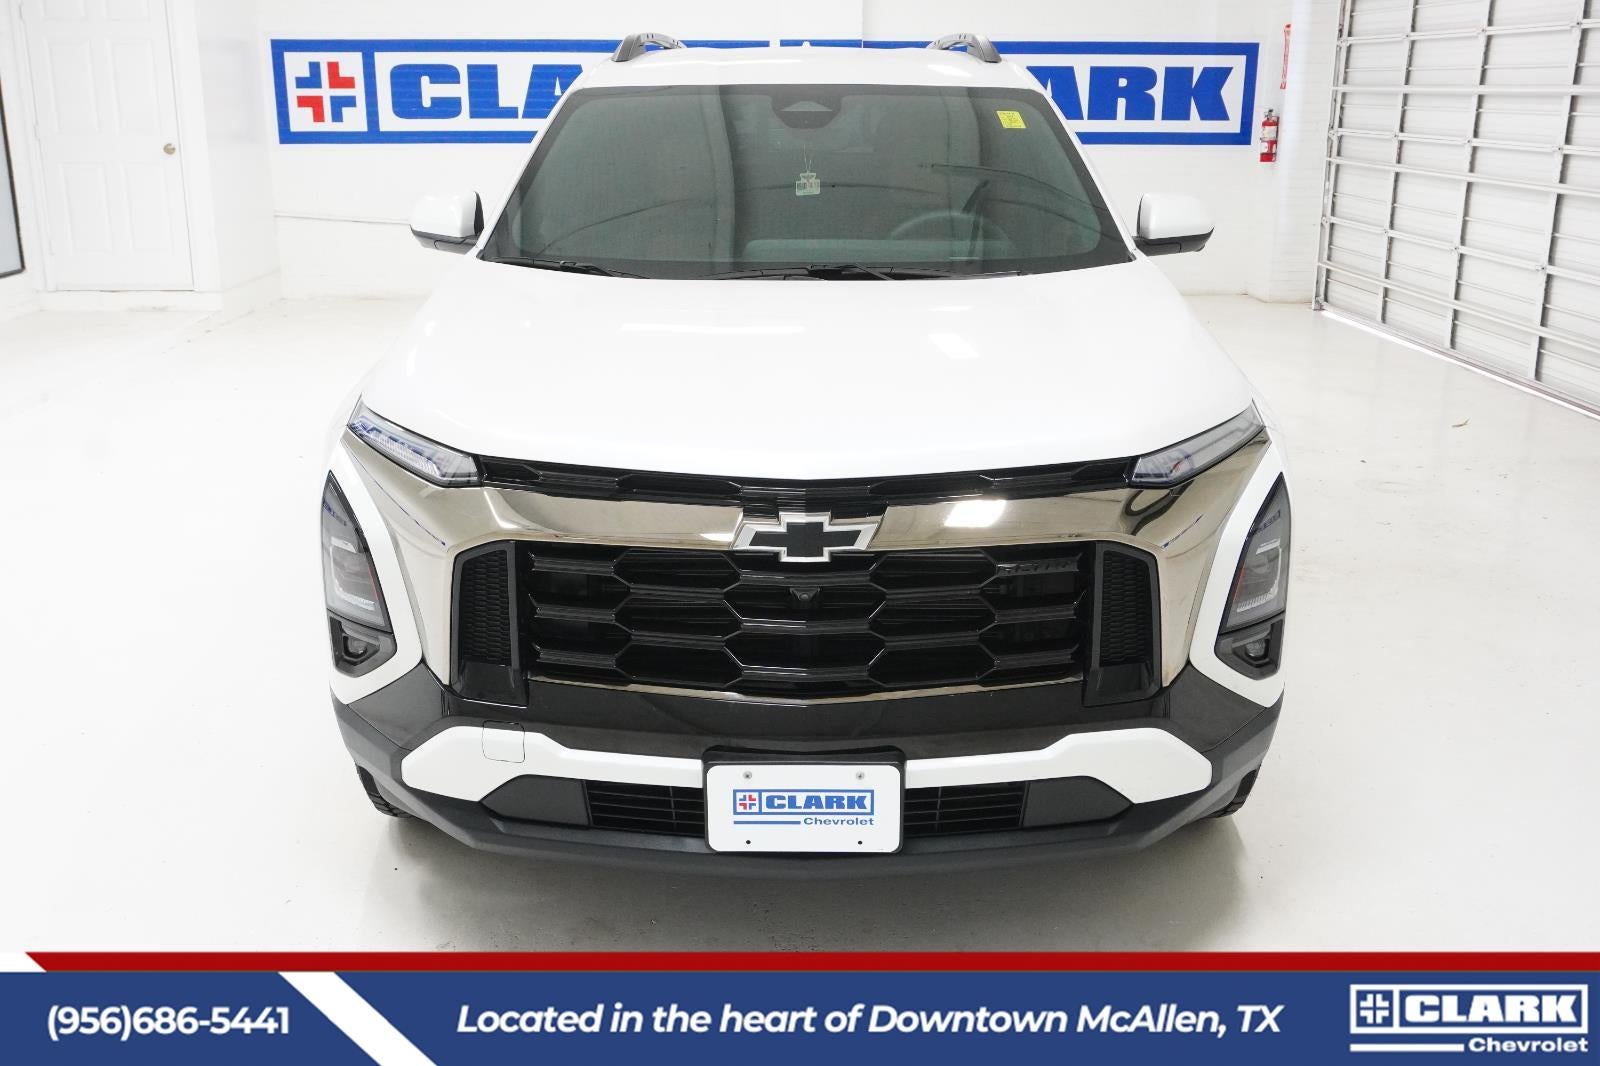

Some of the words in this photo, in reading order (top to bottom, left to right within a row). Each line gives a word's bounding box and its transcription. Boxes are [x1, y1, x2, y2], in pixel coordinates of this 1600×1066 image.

[389, 63, 583, 120] CLA
[1026, 65, 1234, 121] ARK
[765, 795, 868, 810] CLARK
[803, 817, 875, 826] Chevrolet
